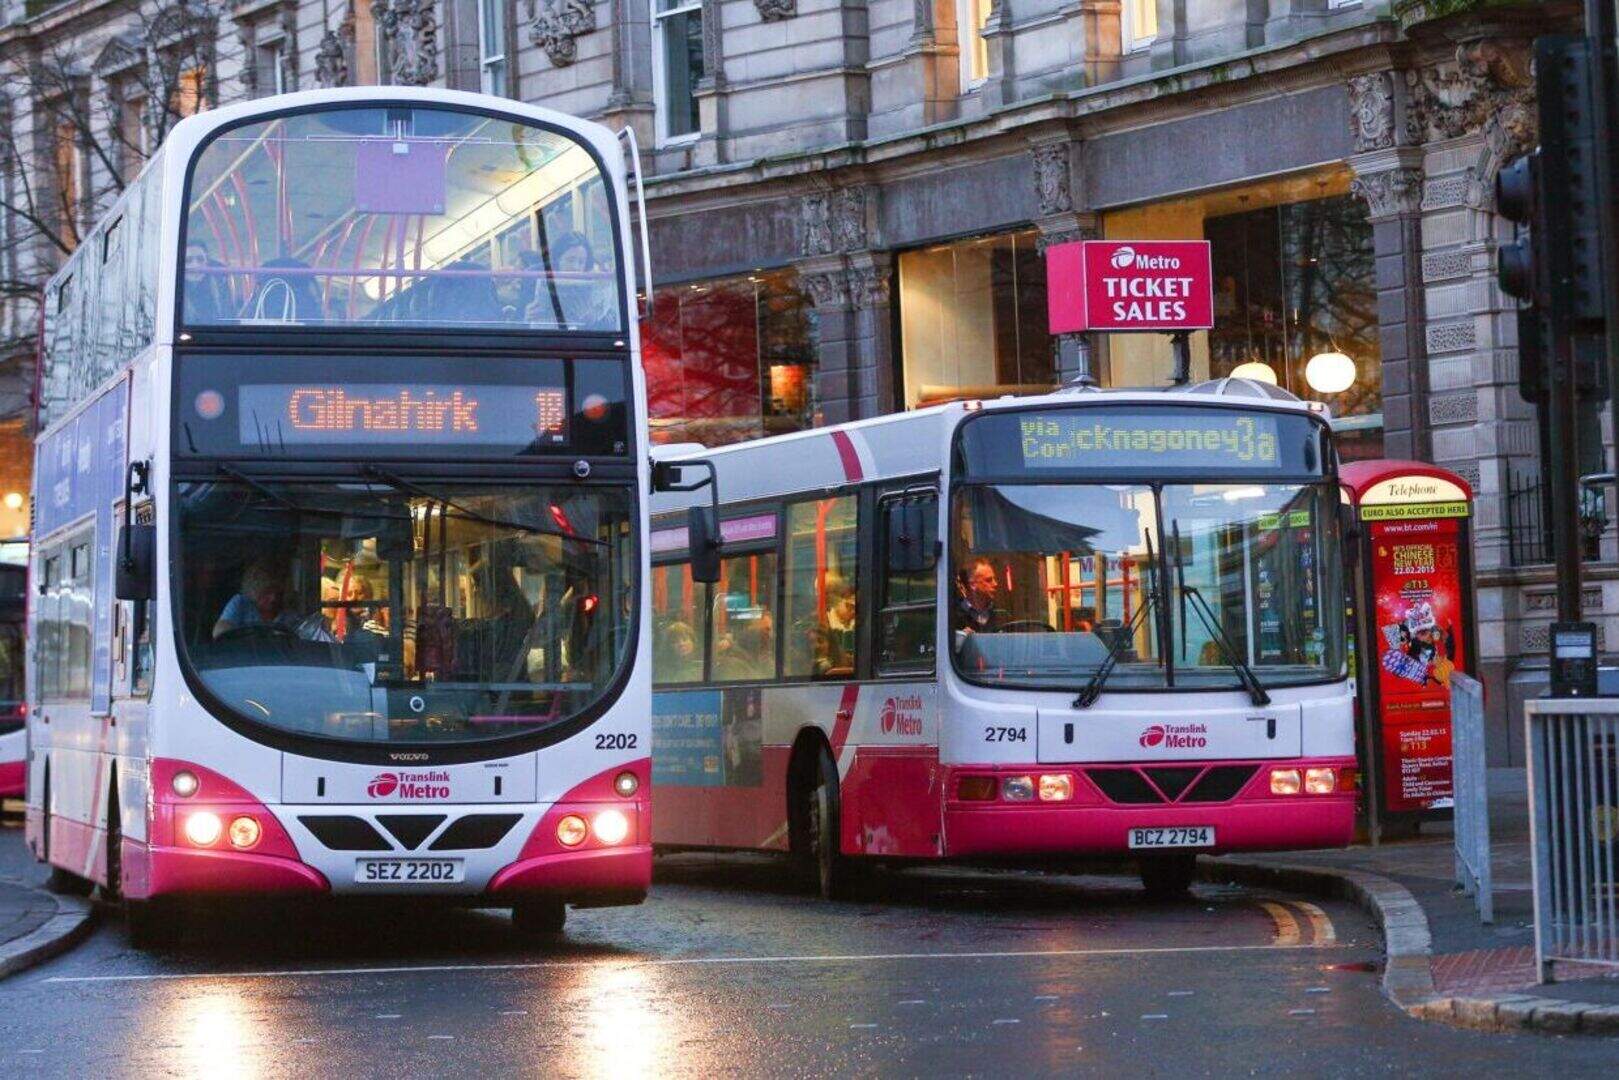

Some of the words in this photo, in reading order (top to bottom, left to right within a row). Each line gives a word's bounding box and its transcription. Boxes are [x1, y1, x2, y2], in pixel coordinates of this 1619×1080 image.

[1136, 254, 1181, 270] Metro
[1102, 277, 1194, 298] TICKET
[1112, 301, 1187, 321] SALES
[288, 388, 479, 431] Gilnahirk
[1020, 416, 1061, 436] via
[1388, 482, 1438, 500] Telephone
[1362, 510, 1384, 518] EURO
[1385, 508, 1405, 517] ALSO
[1407, 506, 1445, 516] ACCEPTED
[1447, 505, 1466, 513] HERE
[1393, 550, 1434, 560] CHINESE
[1394, 560, 1412, 568] NEW
[1413, 559, 1434, 568] YEAR
[1394, 566, 1435, 575] 22.02.2015
[896, 713, 923, 736] Metro
[1164, 723, 1208, 735] Translink
[594, 733, 638, 750] 2202
[985, 727, 1027, 743] 2794
[1164, 735, 1207, 748] Metro
[390, 753, 429, 761] VOLVO
[399, 770, 450, 783] Translink
[399, 784, 450, 799] Metro
[1134, 830, 1164, 846] BCZ
[1168, 828, 1208, 845] 2794
[365, 862, 401, 880] SEZ
[406, 862, 455, 880] 2202
